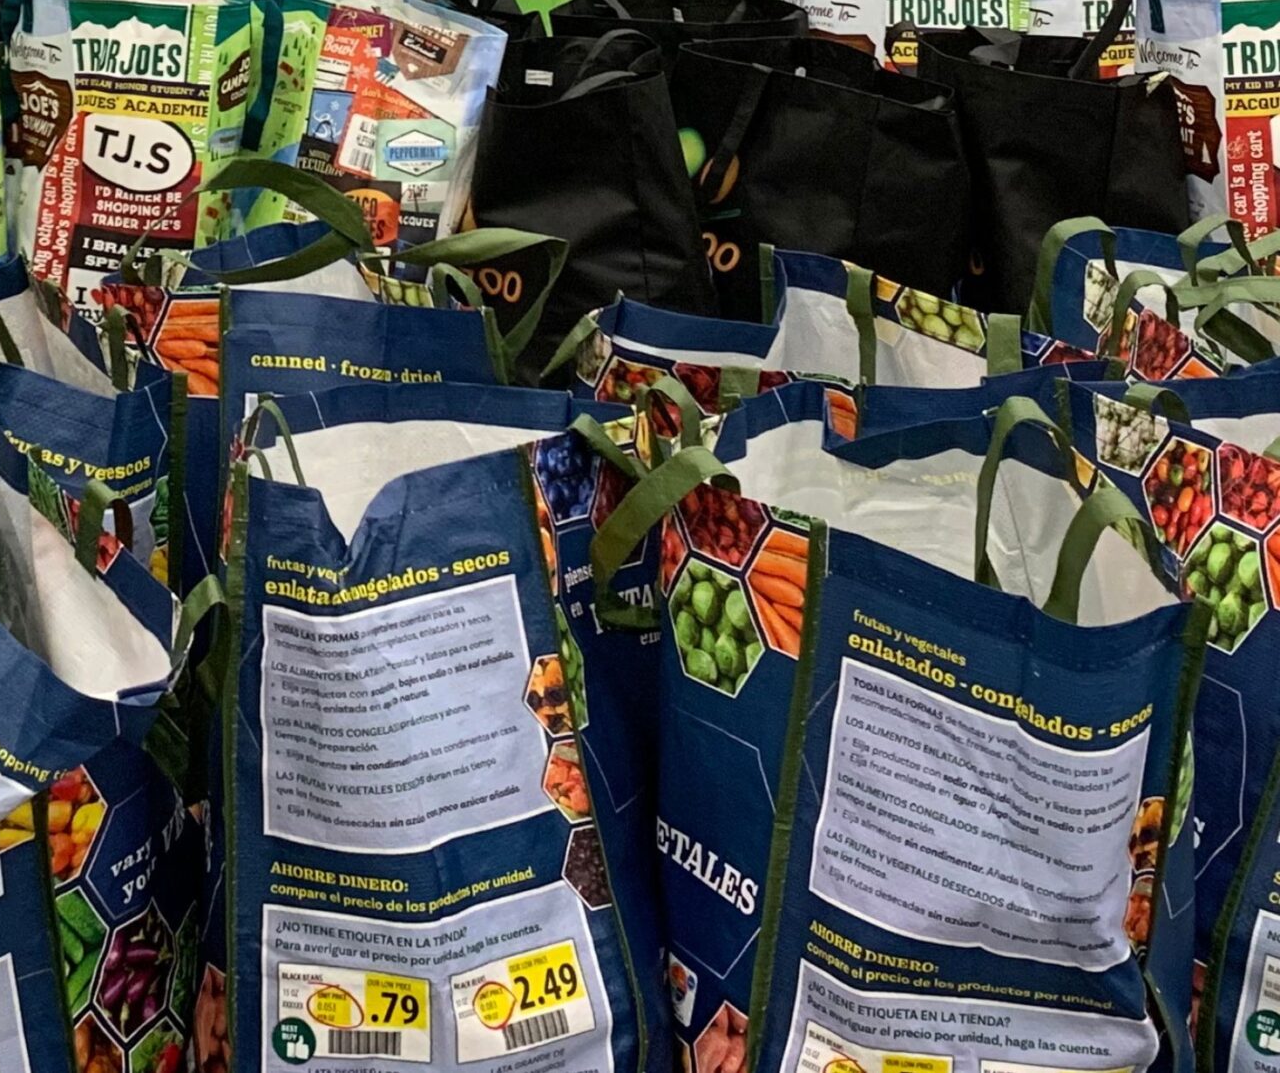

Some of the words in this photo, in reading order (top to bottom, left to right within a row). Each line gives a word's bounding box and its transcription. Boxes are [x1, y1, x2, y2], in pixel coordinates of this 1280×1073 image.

[150, 84, 195, 96] STUDENT
[1225, 82, 1243, 90] MY
[20, 91, 60, 119] JOE'S
[1225, 97, 1280, 111] JACQU
[389, 146, 442, 160] PEPPERMINT
[1248, 130, 1263, 159] cart
[43, 180, 57, 207] car
[58, 156, 79, 217] shopping
[94, 185, 111, 198] I'D
[166, 192, 182, 203] BE
[1251, 162, 1270, 220] shopping
[91, 213, 139, 229] TRADER
[96, 199, 160, 217] SHOPPING
[38, 209, 56, 248] other
[55, 219, 71, 258] Joe's
[251, 354, 327, 373] canned
[266, 554, 306, 574] frutas
[452, 550, 511, 577] secos
[319, 630, 360, 643] FORMAS
[853, 608, 894, 635] frutas
[904, 631, 967, 667] vegetales
[848, 631, 956, 689] enlatados
[1109, 702, 1154, 739] secos
[865, 721, 923, 751] ALIMENTOS
[871, 743, 921, 770] productos
[336, 783, 394, 796] VEGETALES
[908, 799, 980, 836] CONGELADOS
[109, 836, 152, 878] vary
[656, 816, 759, 916] ETALES
[270, 860, 337, 885] AHORRE
[338, 874, 410, 894] DINERO:
[270, 883, 327, 903] compare
[330, 888, 341, 903] el
[342, 891, 384, 913] precio
[386, 898, 404, 912] de
[405, 899, 426, 914] los
[470, 880, 490, 897] por
[491, 866, 537, 889] unidad.
[885, 853, 940, 885] VEGETALES
[941, 877, 1006, 908] DESECADOS
[275, 921, 302, 936] ¿NO
[303, 923, 337, 938] TIENE
[337, 929, 395, 947] ETIQUETA
[396, 936, 414, 948] EN
[417, 936, 432, 949] LA
[275, 938, 297, 952] Para
[298, 941, 359, 963] averiguar
[372, 951, 408, 968] precio
[410, 955, 431, 968] por
[501, 924, 543, 943] cuentas.
[809, 919, 864, 961] AHORRE
[864, 946, 941, 975] DINERO:
[513, 962, 578, 1012] 2.49
[806, 942, 851, 976] compare
[865, 967, 911, 991] precio
[913, 975, 932, 989] de
[933, 977, 956, 991] los
[957, 979, 1032, 1002] productos
[1034, 989, 1059, 1004] por
[1061, 992, 1116, 1012] unidad.
[370, 991, 420, 1025] .79
[827, 988, 856, 1013] TIENE
[857, 1003, 919, 1022] ETIQUETA
[920, 1009, 938, 1023] EN
[940, 1010, 958, 1024] LA
[959, 1012, 1012, 1028] TIENDA?
[281, 1024, 299, 1033] BEST
[282, 1032, 298, 1041] BUY
[879, 1024, 891, 1038] el
[893, 1026, 933, 1042] precio
[934, 1030, 956, 1043] por
[958, 1029, 1004, 1049] unidad,
[1005, 1035, 1036, 1052] haga
[1037, 1038, 1057, 1052] las
[1058, 1043, 1113, 1057] cuentas.
